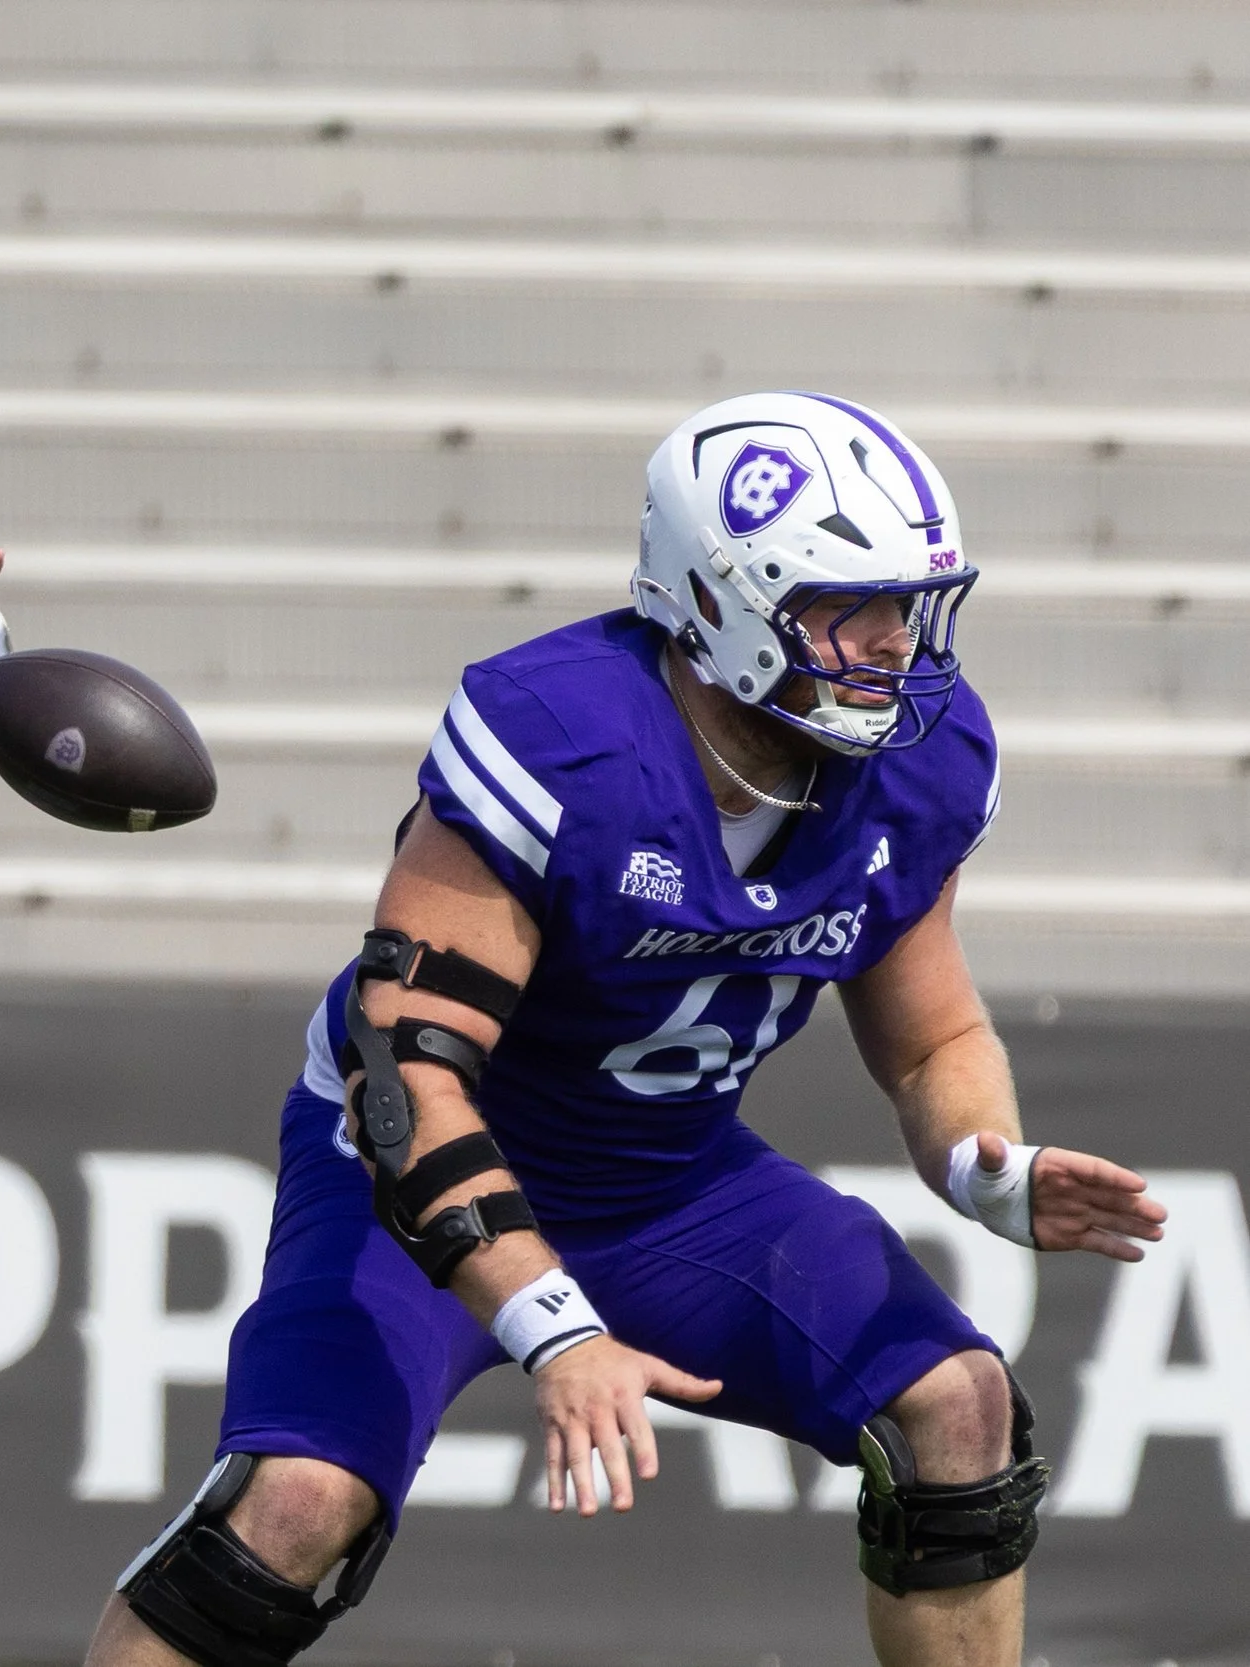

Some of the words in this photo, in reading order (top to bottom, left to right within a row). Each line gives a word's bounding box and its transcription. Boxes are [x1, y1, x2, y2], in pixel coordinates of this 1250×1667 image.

[929, 549, 957, 571] 508
[618, 880, 684, 906] LEAGUE
[622, 870, 685, 895] PATRIOT
[623, 927, 747, 959] HOLY
[738, 903, 868, 959] CROSS
[598, 973, 803, 1096] 61
